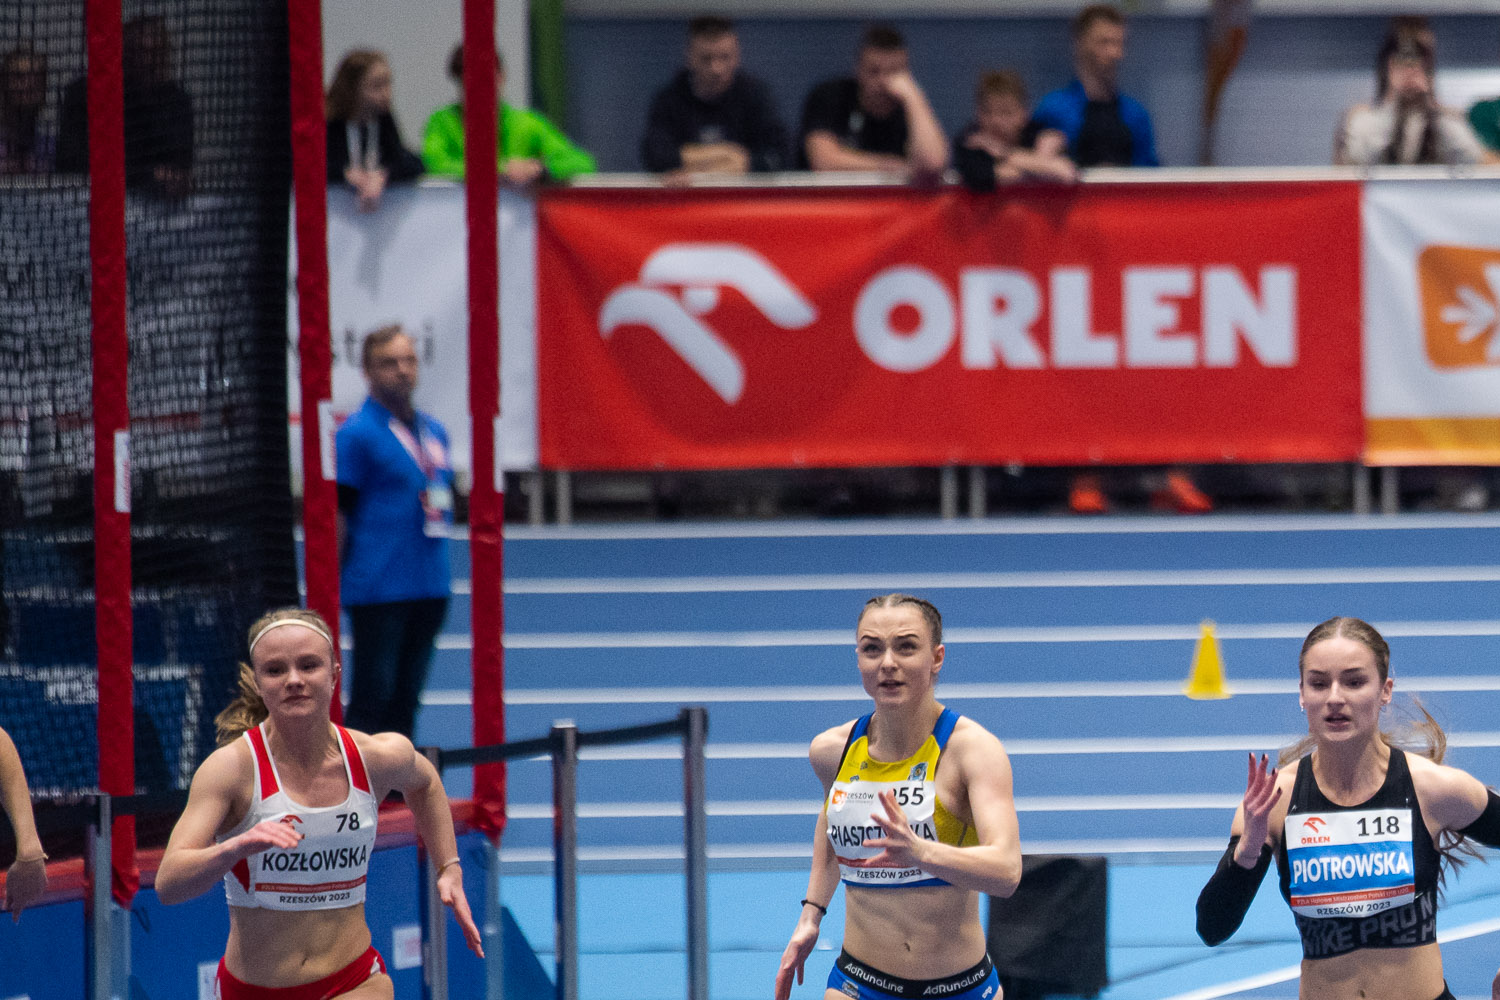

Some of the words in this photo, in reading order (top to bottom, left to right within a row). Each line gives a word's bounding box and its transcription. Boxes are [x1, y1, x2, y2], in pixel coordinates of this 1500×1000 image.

[853, 264, 1297, 373] ORLEN
[893, 787, 924, 806] 55
[336, 812, 360, 833] 78
[1357, 816, 1400, 837] 118
[1301, 836, 1331, 845] ORLEN
[262, 845, 367, 872] KOZŁOWSKA
[1293, 852, 1410, 884] PIOTROWSKA
[898, 869, 922, 879] 2023
[280, 894, 327, 904] RZESZÓW
[329, 892, 351, 902] 2023
[1316, 904, 1364, 915] RZESZÓW
[1367, 901, 1391, 911] 2023
